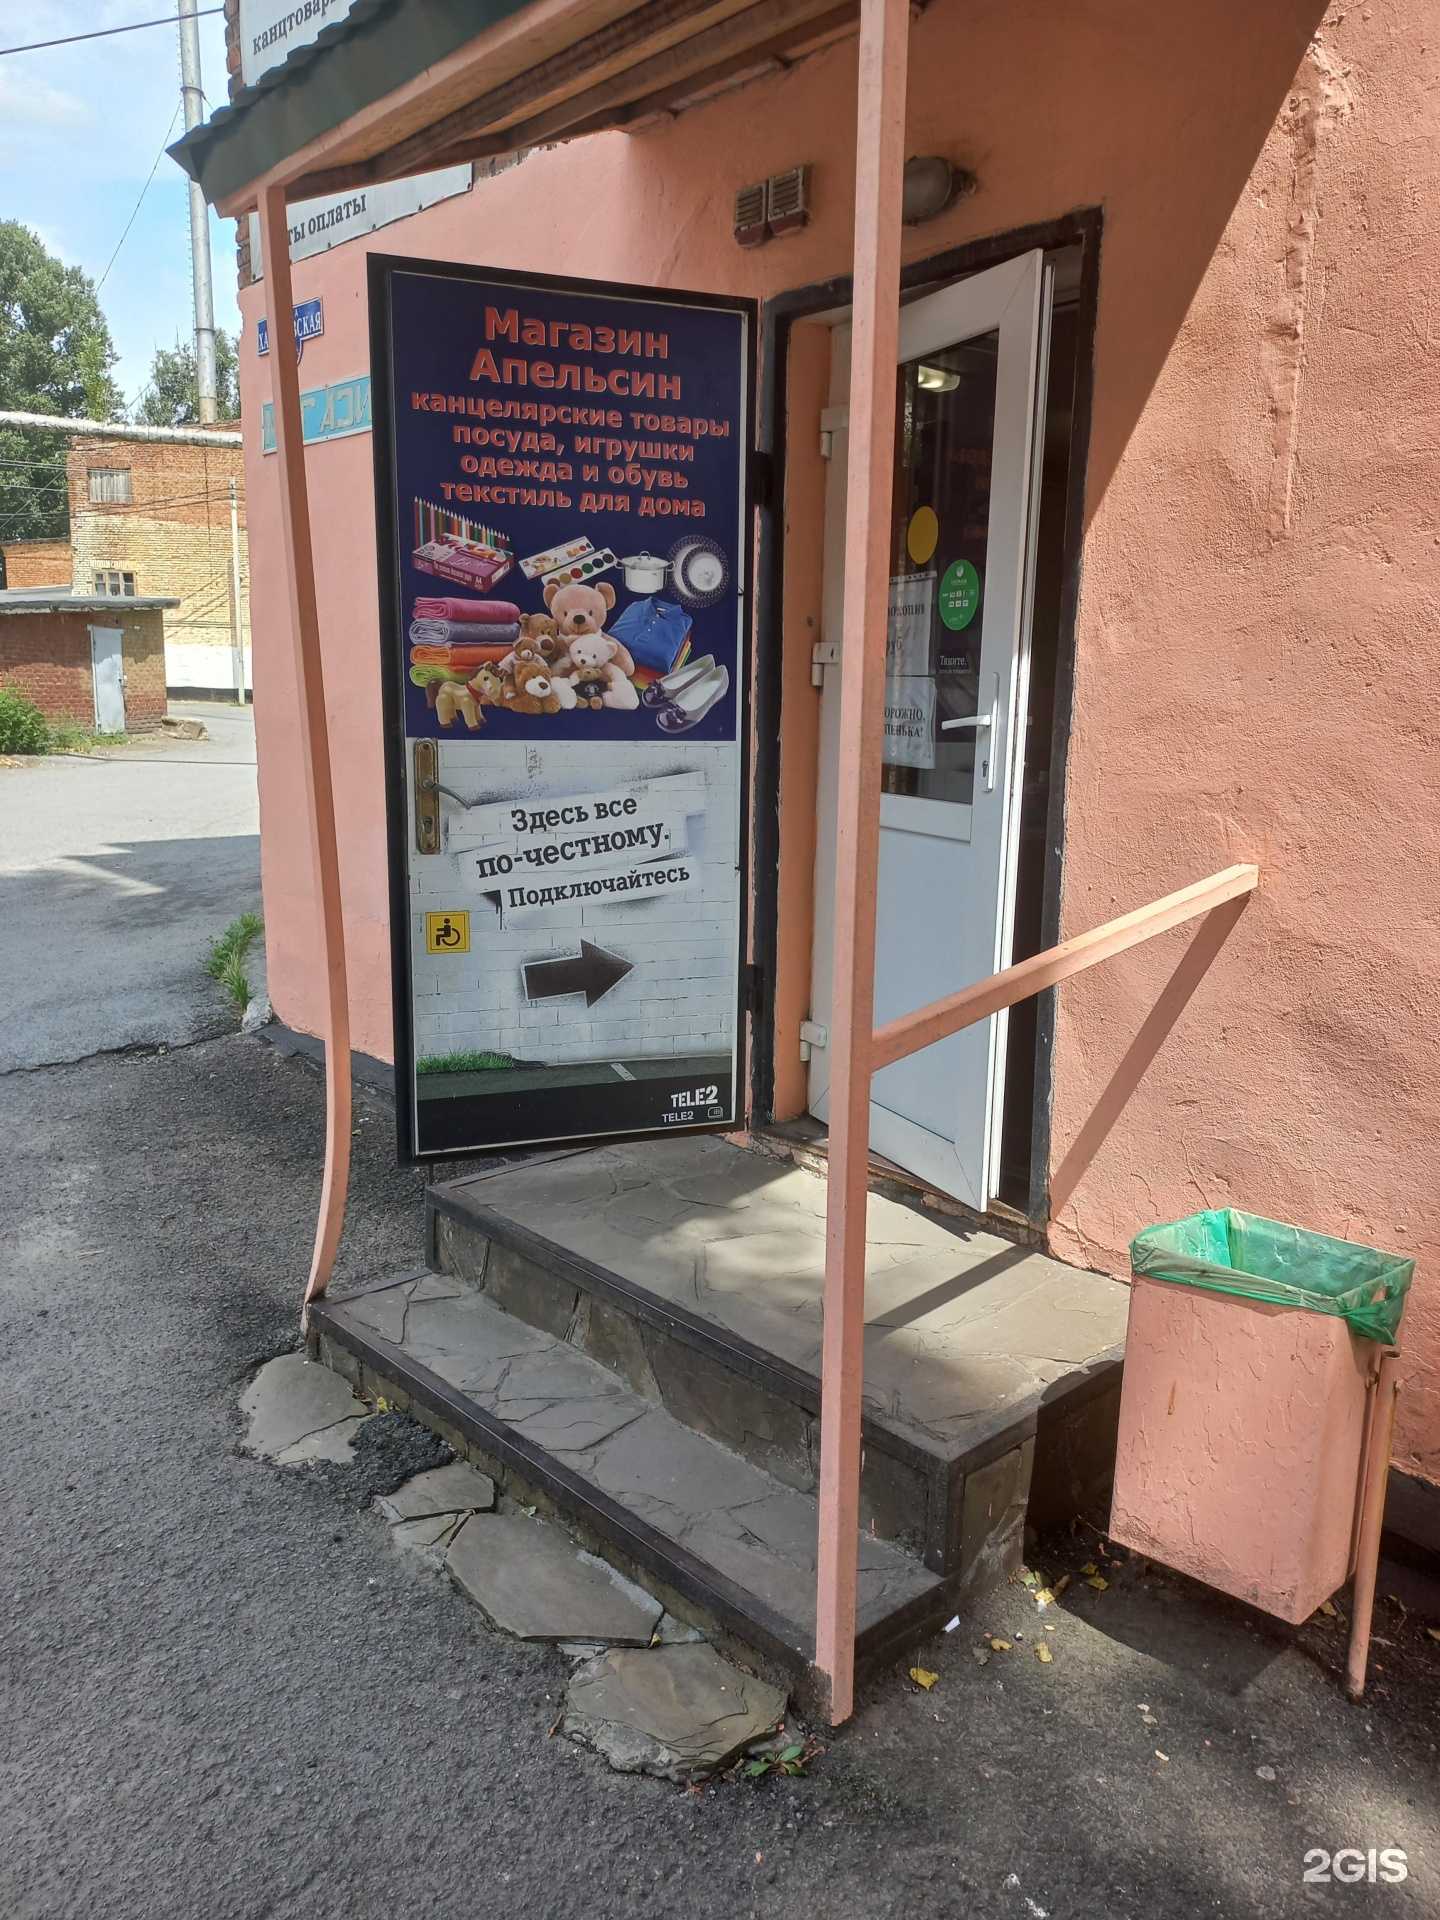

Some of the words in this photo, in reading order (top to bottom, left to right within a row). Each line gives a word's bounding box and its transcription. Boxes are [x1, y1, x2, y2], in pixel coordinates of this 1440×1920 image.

[252, 0, 336, 56] канцтовар
[307, 194, 367, 236] оплаты
[484, 305, 670, 360] Магазин
[469, 347, 682, 401] Апельсин
[410, 390, 623, 428] канцелярские
[630, 410, 730, 440] товары
[452, 422, 565, 456] посуда,
[574, 433, 695, 463] игрушки
[459, 453, 573, 483] одежда
[582, 464, 600, 482] и
[607, 463, 690, 492] обувь
[439, 480, 572, 509] текстиль
[579, 489, 630, 513] для
[637, 494, 707, 519] дома
[510, 799, 588, 832] Здесь
[594, 797, 639, 819] все
[475, 820, 671, 879] по-честному.
[507, 864, 691, 909] Подключайтесь
[661, 1110, 695, 1123] TELE2
[670, 1085, 719, 1108] TELE2
